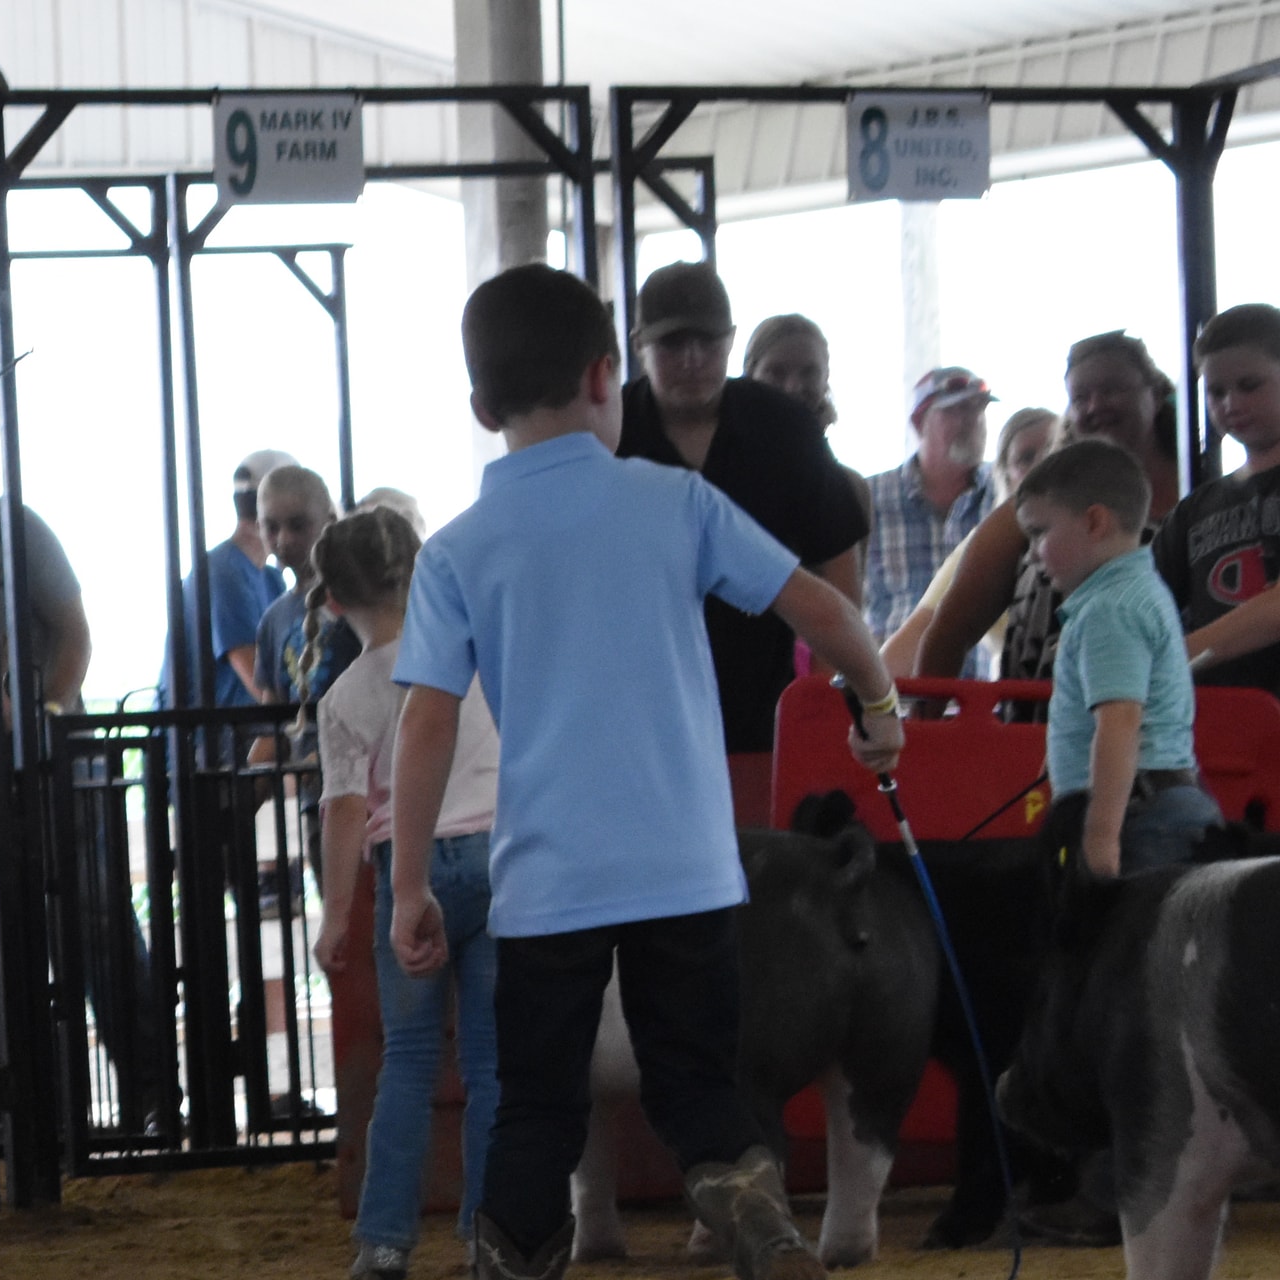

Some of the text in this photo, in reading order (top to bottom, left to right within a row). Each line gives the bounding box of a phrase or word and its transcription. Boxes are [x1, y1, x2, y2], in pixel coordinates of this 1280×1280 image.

[259, 109, 353, 131] MARK IV
[226, 109, 258, 197] 9
[276, 140, 338, 162] FARM
[860, 106, 890, 192] 8
